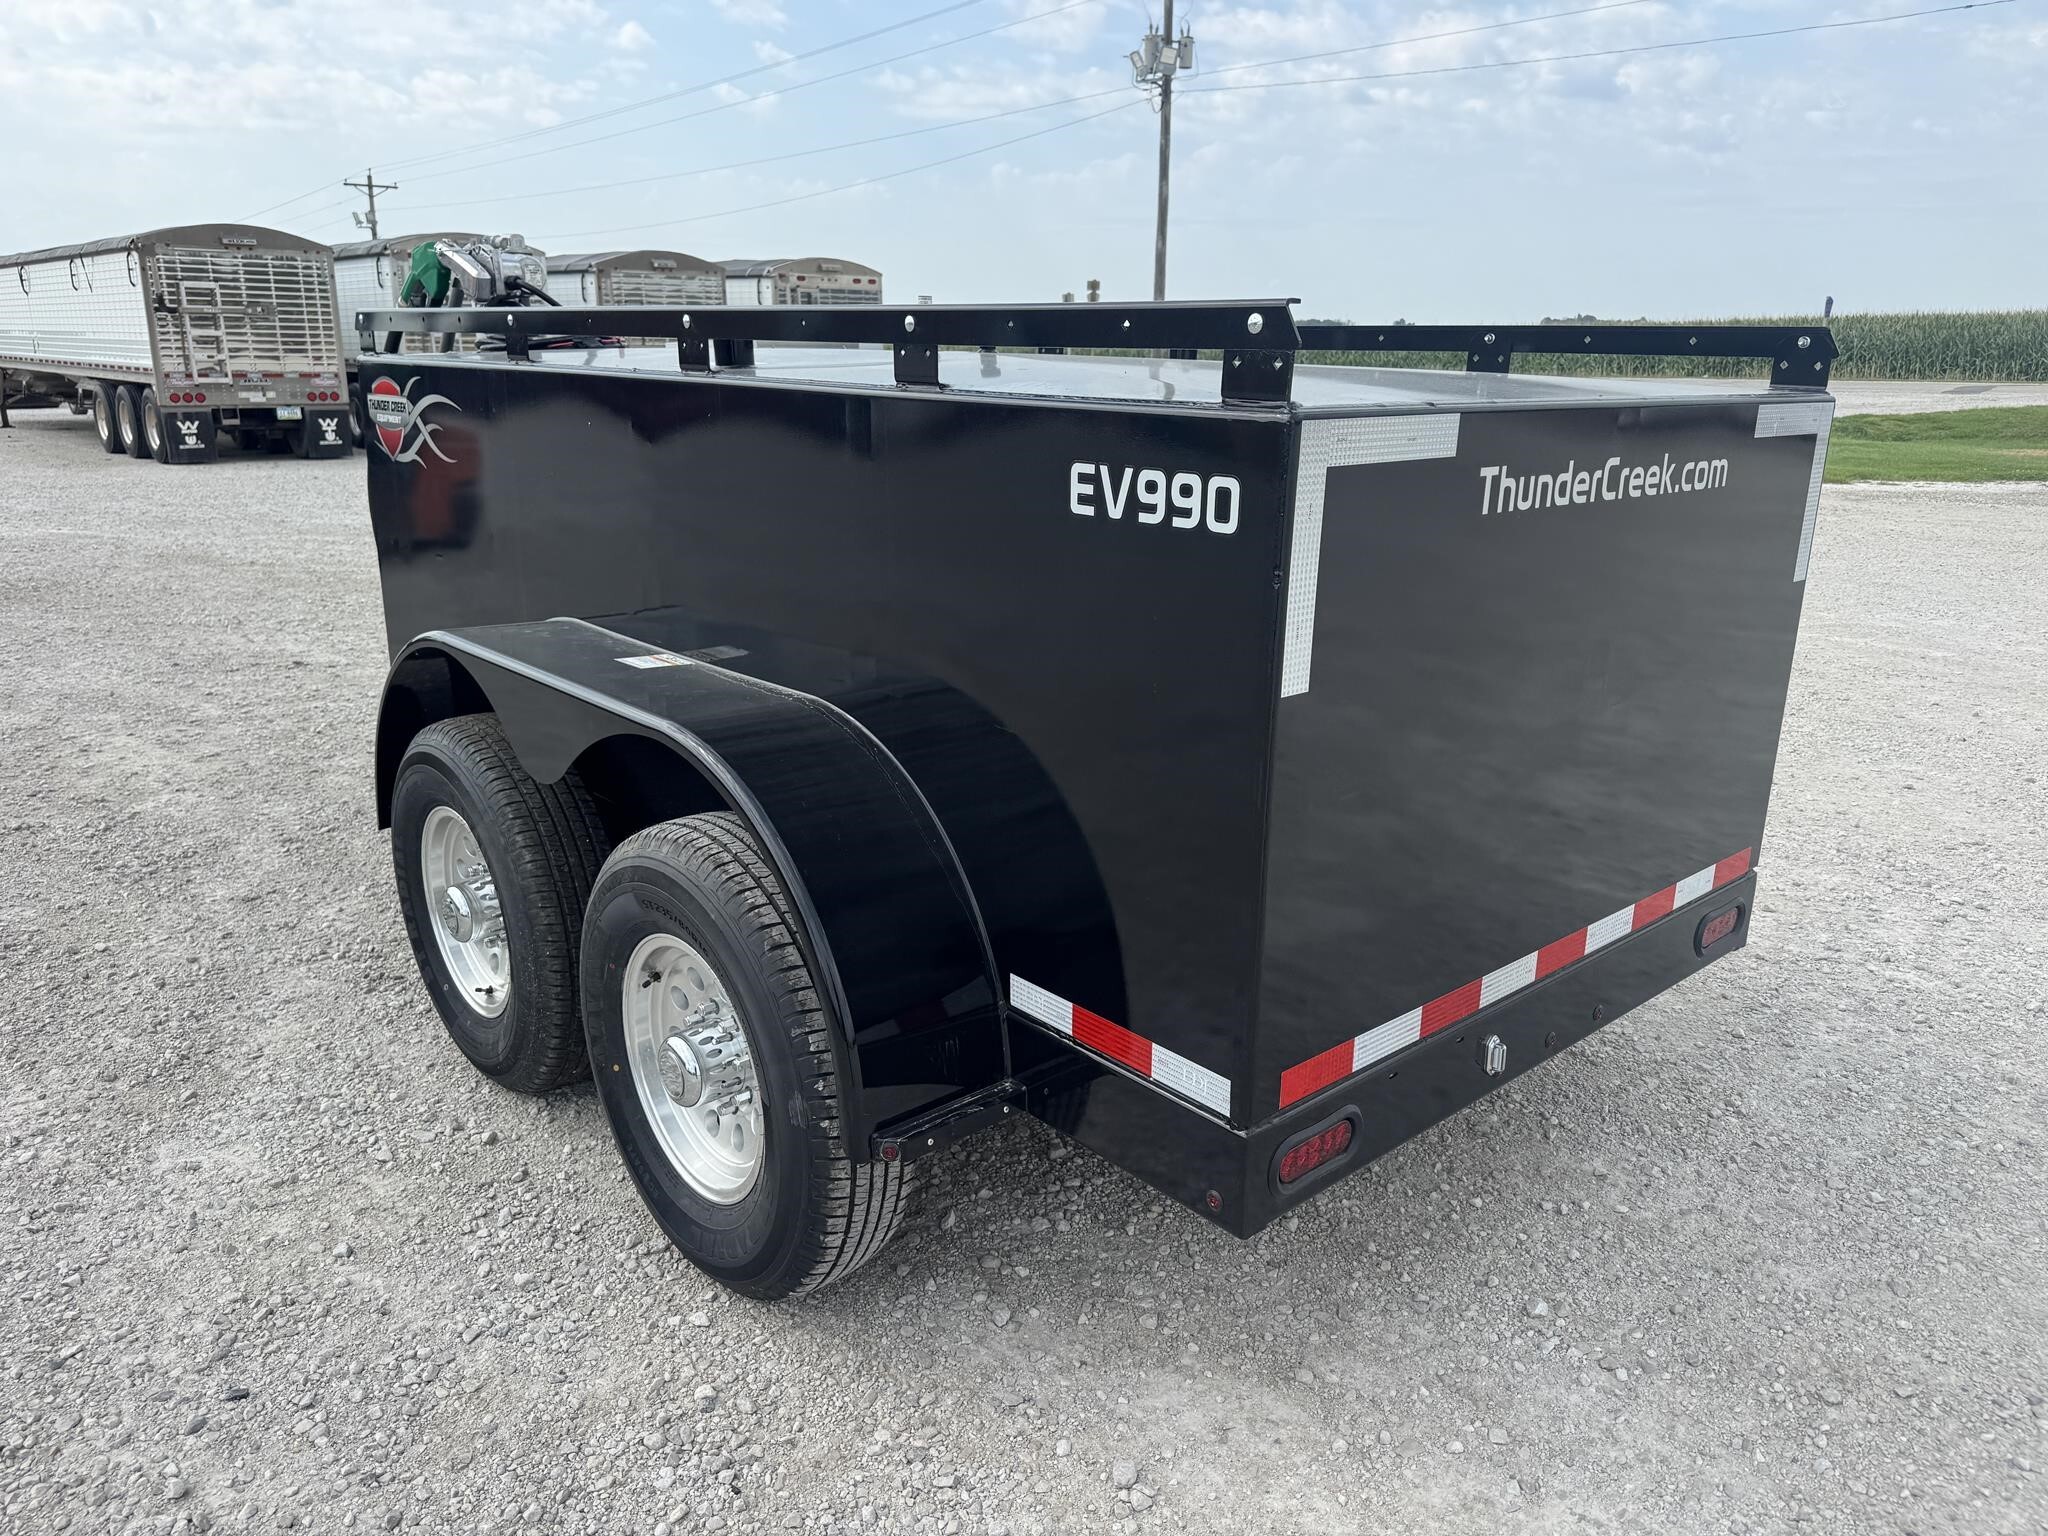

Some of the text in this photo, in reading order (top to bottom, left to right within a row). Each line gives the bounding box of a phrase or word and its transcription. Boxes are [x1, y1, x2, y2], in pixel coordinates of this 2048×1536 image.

[369, 399, 407, 413] THUNDER CREEK
[376, 413, 402, 424] EQUIPMENT
[1069, 461, 1242, 536] EV990
[1480, 453, 1729, 516] ThunderCreek.com
